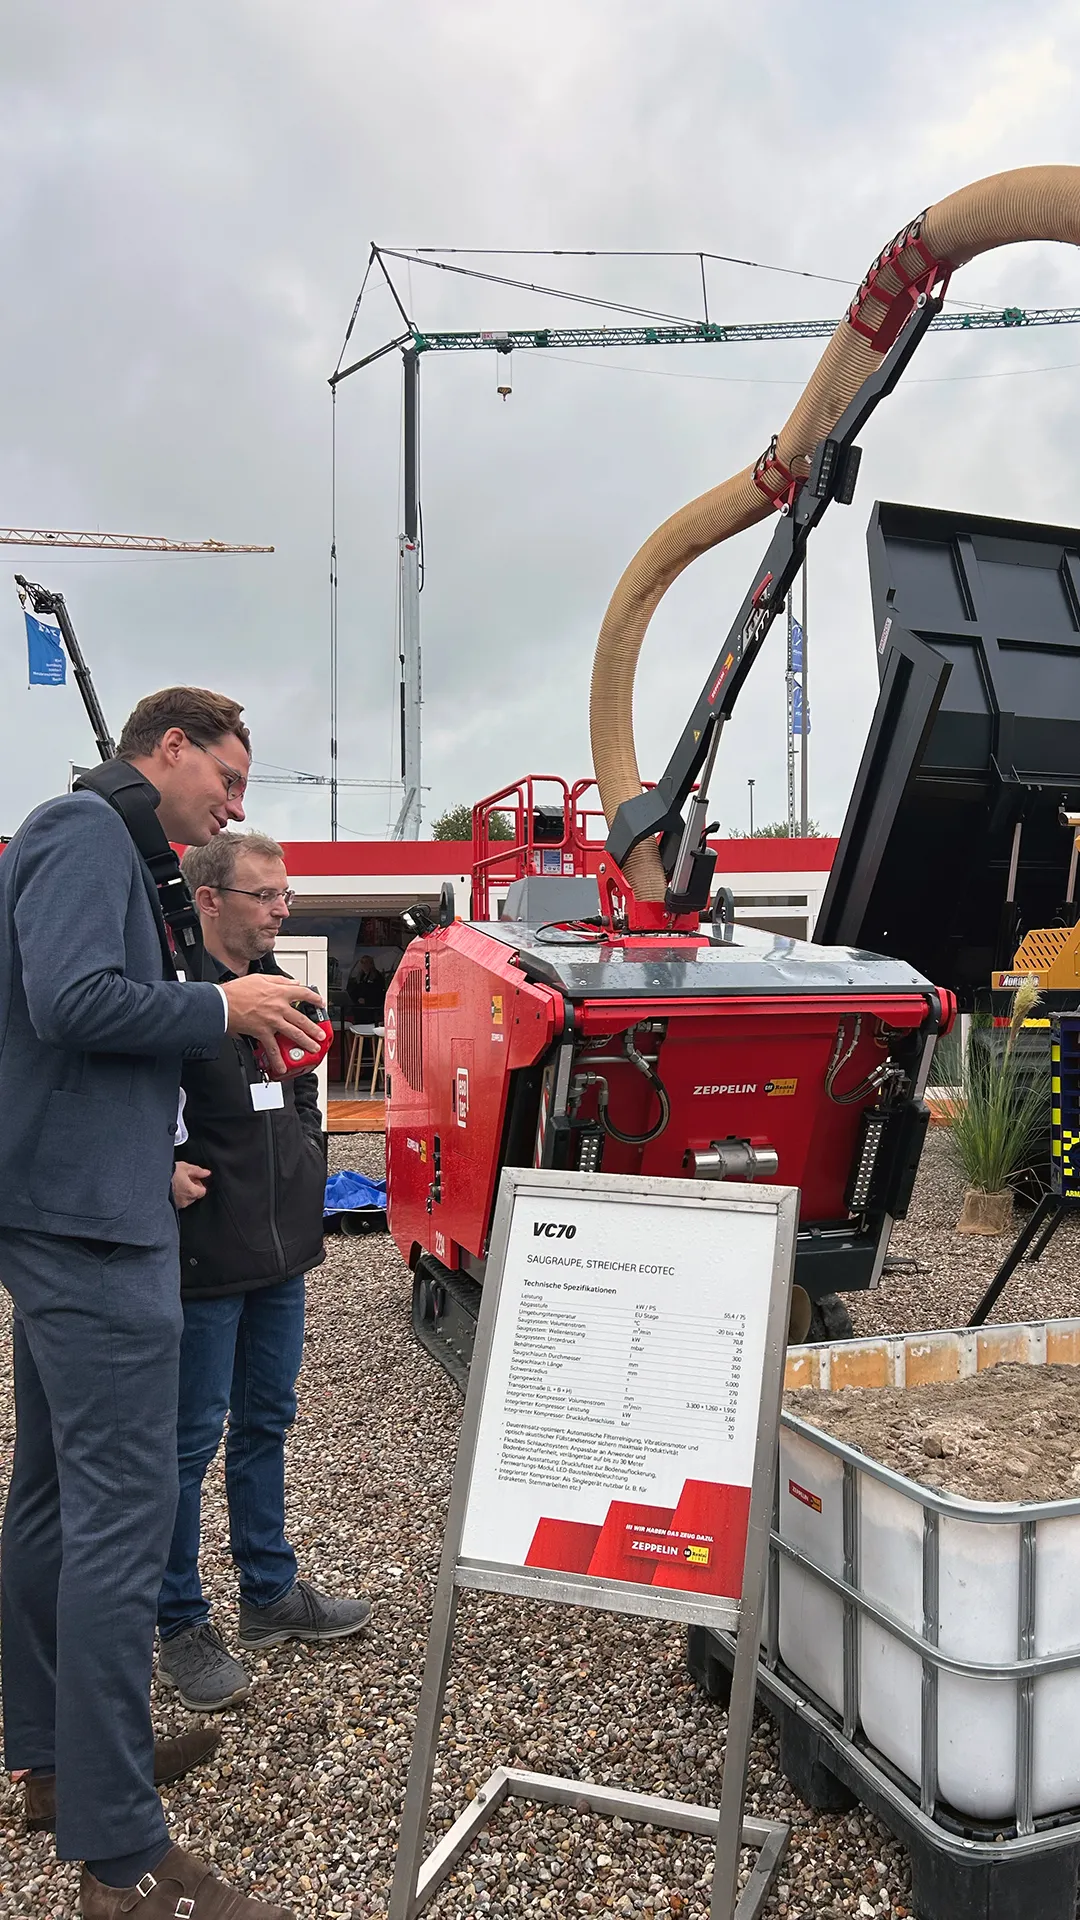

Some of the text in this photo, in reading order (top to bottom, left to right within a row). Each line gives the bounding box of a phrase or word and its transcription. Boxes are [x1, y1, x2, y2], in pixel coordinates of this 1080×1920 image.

[693, 1084, 757, 1095] ZEPPELIN
[533, 1222, 577, 1239] VC70
[527, 1254, 675, 1276] SAUGRAUPE, STREICHER ECOTEC
[523, 1279, 617, 1295] Technische Spezifikationen
[521, 1293, 543, 1301] Leistung
[520, 1301, 548, 1310] Abgasstufe
[519, 1309, 576, 1320] Umgebungstemperatur
[550, 1320, 587, 1329] Volumenstrom
[549, 1329, 586, 1338] Wellenleistung
[514, 1341, 556, 1350] Behältervolumen
[513, 1349, 547, 1359] Saugschlauch
[549, 1353, 581, 1361] Durchmesser
[511, 1358, 546, 1367] Saugschlauch
[547, 1361, 563, 1369] Länge
[510, 1366, 548, 1375] Schwenkradius
[509, 1374, 543, 1383] Eigengewicht
[508, 1382, 546, 1392] Transportmaße
[505, 1399, 534, 1408] Integrierter
[567, 1406, 590, 1414] Leistung
[506, 1390, 535, 1399] Integrierter
[569, 1397, 606, 1406] Volumenstrom
[725, 1415, 736, 1423] 2,66
[504, 1407, 533, 1416] Integrierter
[566, 1414, 615, 1425] Druckluftanschluss
[567, 1429, 602, 1439] Automatische
[644, 1439, 686, 1449] Vibrationsmotor
[504, 1437, 526, 1445] Flexibles
[571, 1445, 598, 1455] Anpassbar
[608, 1450, 634, 1459] Anwender
[556, 1435, 596, 1445] Füllstandsensor
[599, 1440, 617, 1448] sichern
[619, 1443, 643, 1451] maximale
[644, 1446, 679, 1456] Produktivität
[502, 1452, 526, 1462] Optionale
[562, 1460, 594, 1469] Druckluftset
[560, 1451, 593, 1462] verlängerbar
[499, 1468, 528, 1478] Integrierter
[573, 1477, 602, 1488] Singlegerät
[604, 1481, 623, 1490] nutzbar
[529, 1478, 568, 1489] Stemmarbeiten
[646, 1527, 667, 1535] HABEN
[631, 1541, 679, 1556] ZEPPELIN
